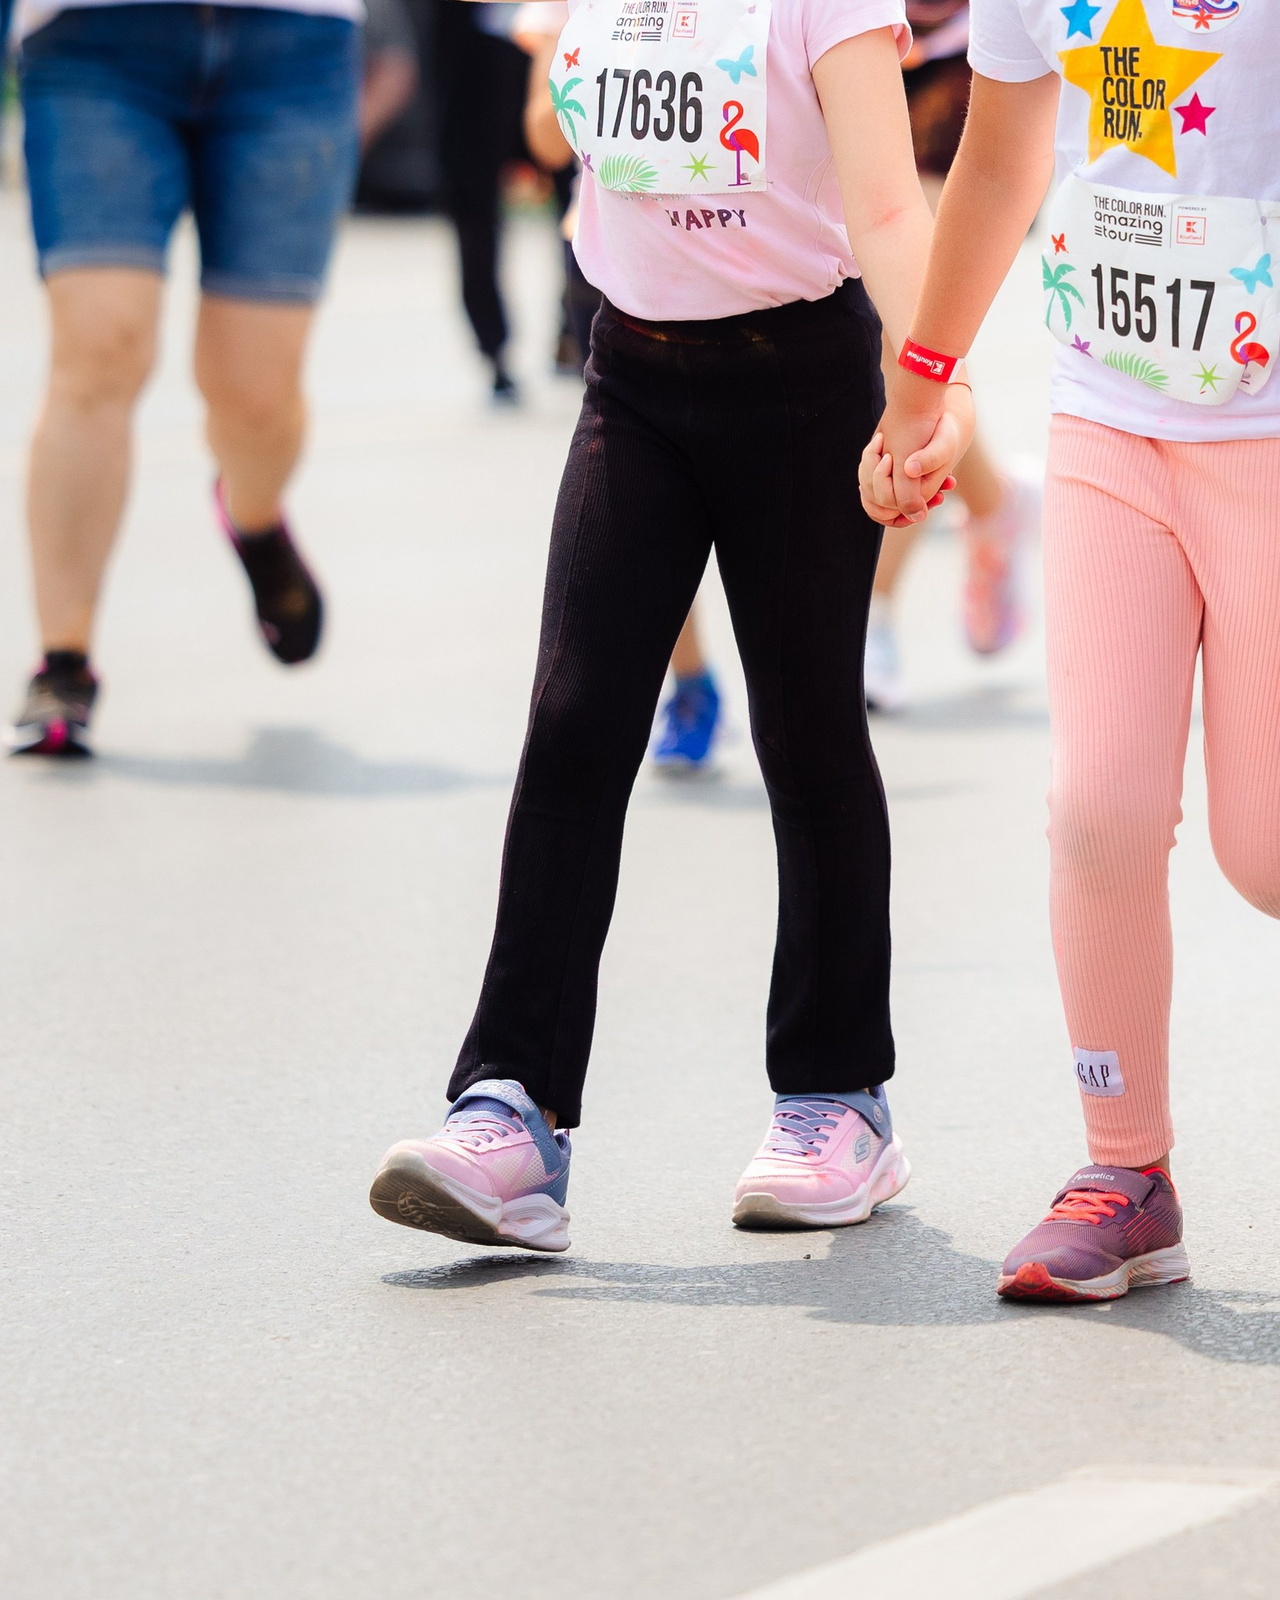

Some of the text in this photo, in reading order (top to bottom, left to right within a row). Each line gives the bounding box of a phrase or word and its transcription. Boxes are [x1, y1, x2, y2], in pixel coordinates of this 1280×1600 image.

[622, 2, 635, 15] THE
[1100, 46, 1140, 77] THE
[596, 68, 703, 143] 17636
[1102, 76, 1166, 110] COLOR
[1093, 195, 1110, 211] THE
[1111, 199, 1143, 215] COLOR
[1093, 211, 1163, 236] amazing
[1103, 225, 1134, 242] tour
[1091, 263, 1215, 351] 15517
[1077, 1062, 1110, 1088] GAP
